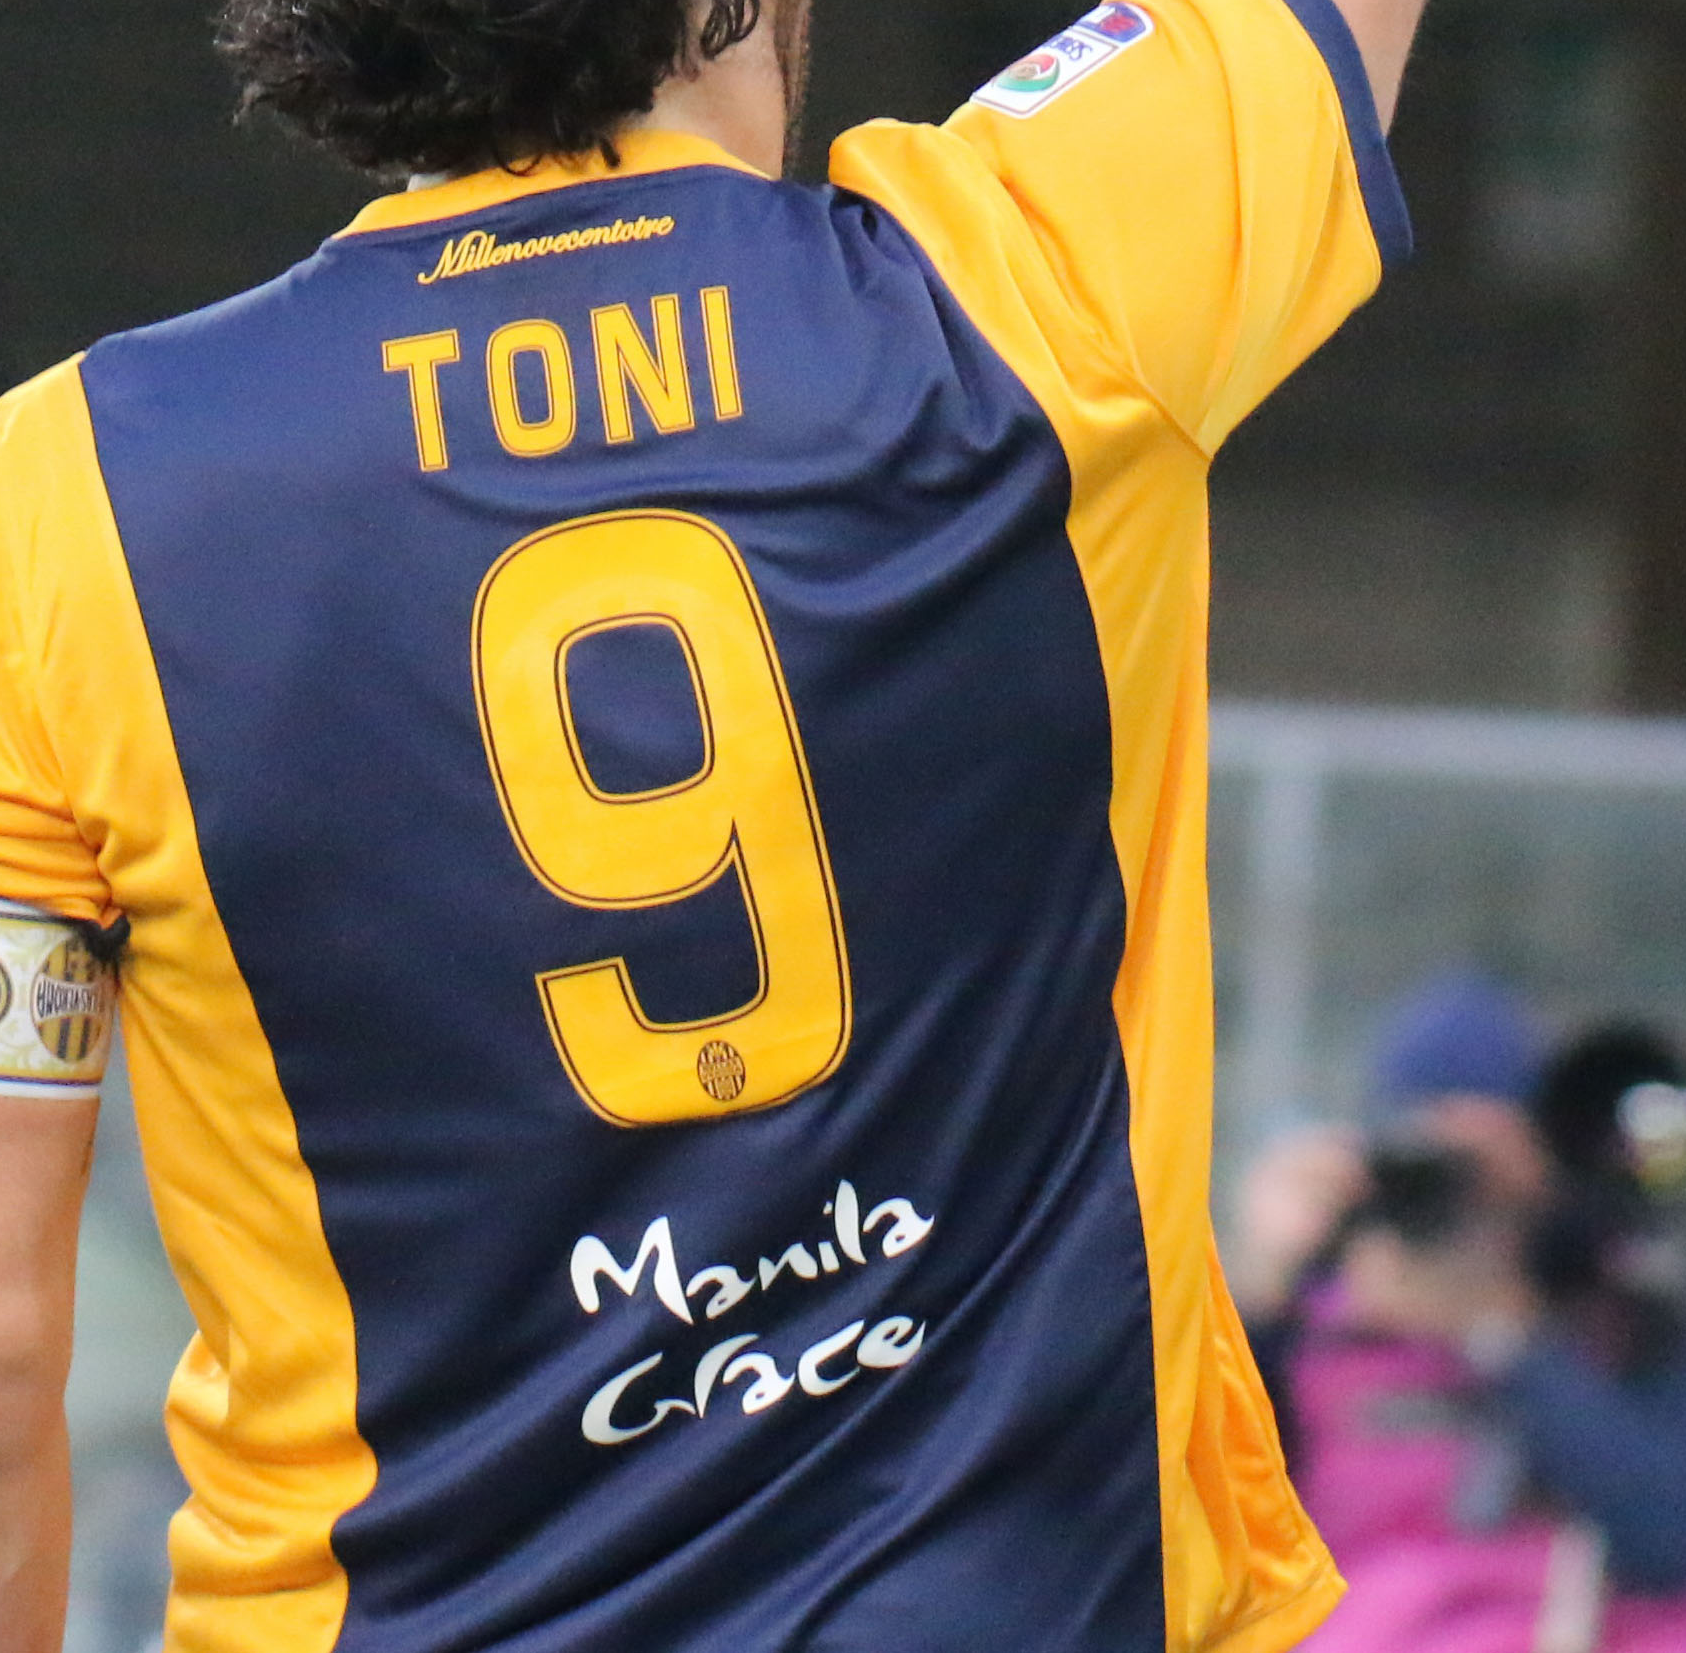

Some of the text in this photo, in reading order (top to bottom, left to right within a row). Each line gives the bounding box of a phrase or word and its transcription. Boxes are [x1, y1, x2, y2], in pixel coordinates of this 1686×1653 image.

[417, 214, 676, 285] Millenovecentotre
[381, 285, 744, 473] TONI
[470, 507, 853, 1129] 9
[570, 1179, 935, 1326] Manila
[581, 1315, 926, 1445] Grace
